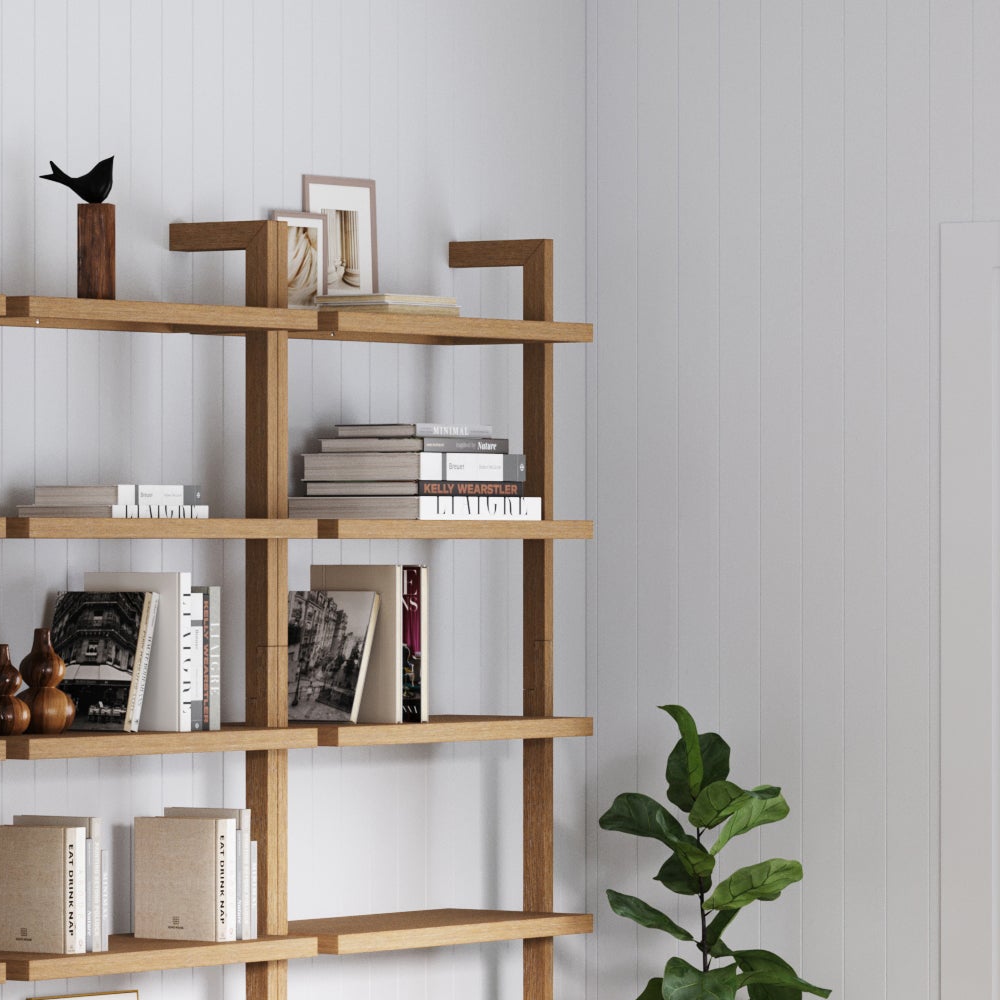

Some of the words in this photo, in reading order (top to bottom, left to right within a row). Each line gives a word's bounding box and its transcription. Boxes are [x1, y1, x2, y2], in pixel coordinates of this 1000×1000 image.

[433, 426, 469, 436] MINIMAL
[477, 441, 497, 451] Nature
[423, 483, 455, 494] KELLY
[457, 484, 518, 495] WEARSTLER
[210, 622, 220, 695] LIAIGRE
